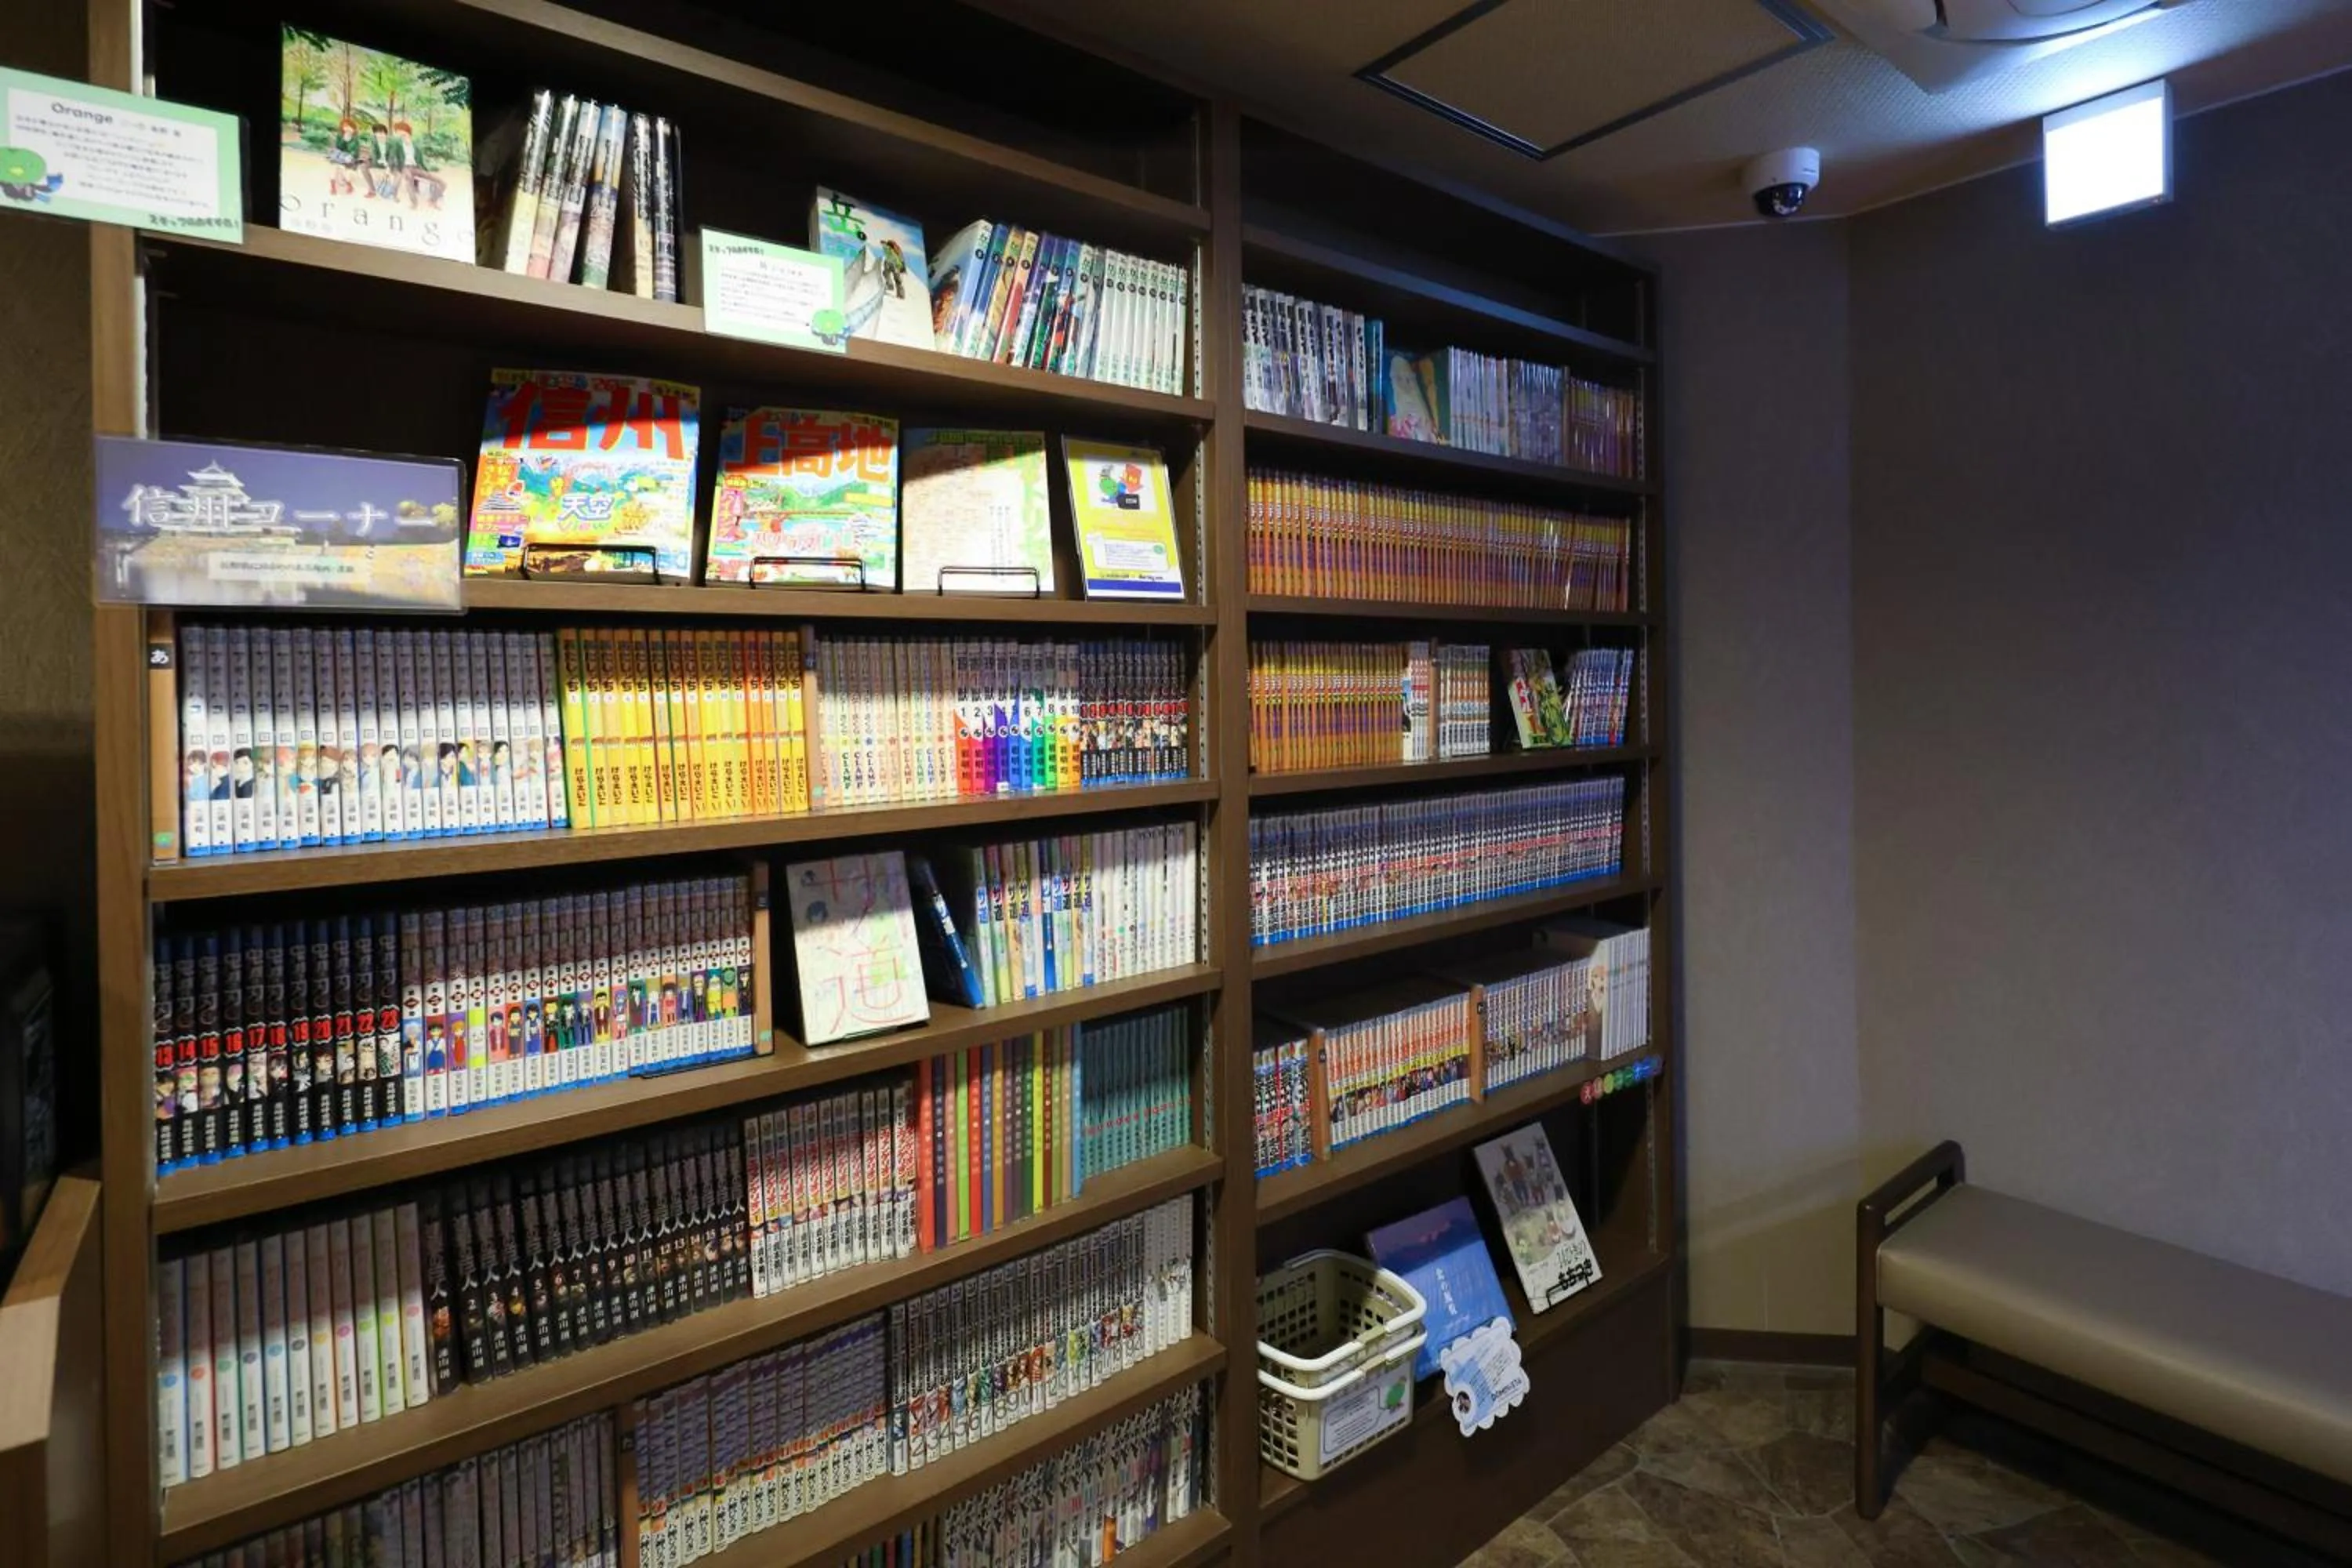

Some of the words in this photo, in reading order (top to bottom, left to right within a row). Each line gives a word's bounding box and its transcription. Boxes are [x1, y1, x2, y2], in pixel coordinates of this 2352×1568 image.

[51, 101, 113, 123] Orange
[499, 382, 684, 461] 信州
[724, 410, 893, 483] 上高地
[123, 483, 437, 538] 信州コーナー
[558, 495, 615, 521] 天空
[151, 649, 169, 664] あ
[975, 706, 981, 717] 2
[987, 705, 993, 716] 3
[1024, 706, 1030, 717] 6
[1036, 706, 1042, 715] 7
[1048, 703, 1054, 713] 8
[1061, 705, 1066, 716] 9
[854, 752, 862, 789] CLAMP
[866, 751, 875, 789] CLAMP
[314, 1020, 330, 1040] 20
[336, 1017, 351, 1036] 21
[358, 1014, 374, 1033] 22
[249, 1027, 264, 1047] 17
[177, 1041, 196, 1062] 14
[734, 1221, 746, 1232] 17
[690, 1234, 700, 1246] 14
[705, 1229, 716, 1241] 15
[659, 1243, 671, 1255] 12
[673, 1238, 685, 1250] 13
[624, 1254, 636, 1266] 10
[641, 1247, 652, 1260] 11
